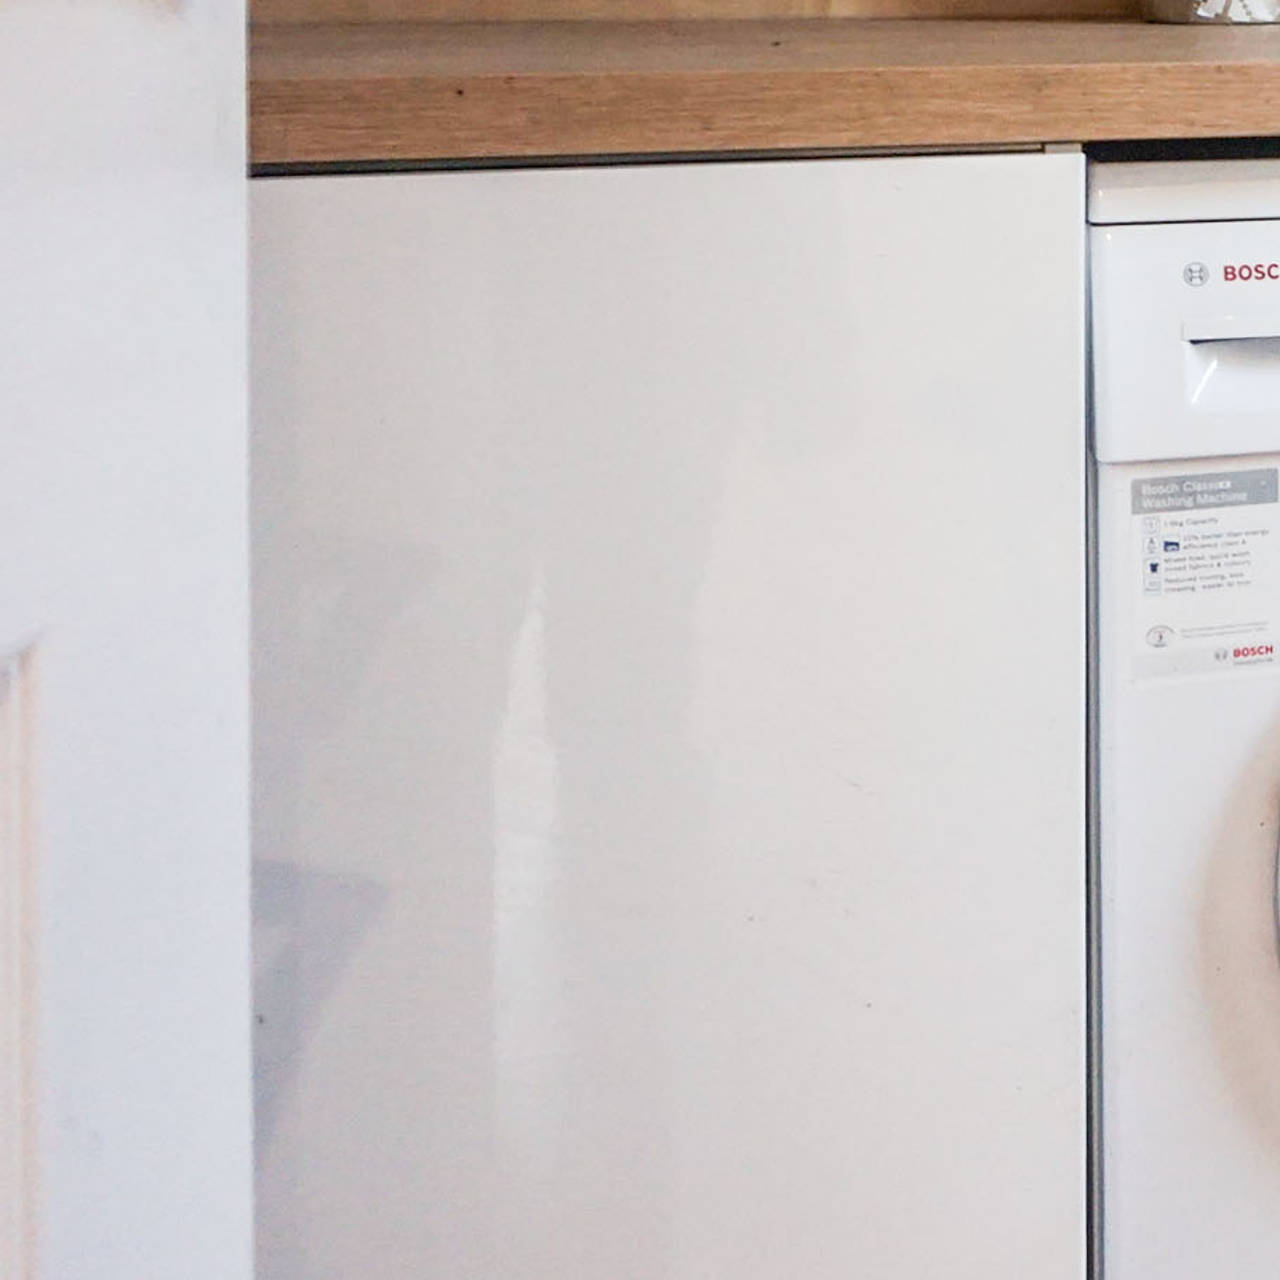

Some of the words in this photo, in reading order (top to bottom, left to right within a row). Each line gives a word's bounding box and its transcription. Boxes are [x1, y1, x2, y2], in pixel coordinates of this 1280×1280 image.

[1143, 494, 1194, 509] Washing
[1197, 491, 1248, 505] Machine
[1232, 645, 1274, 658] BOSCH
